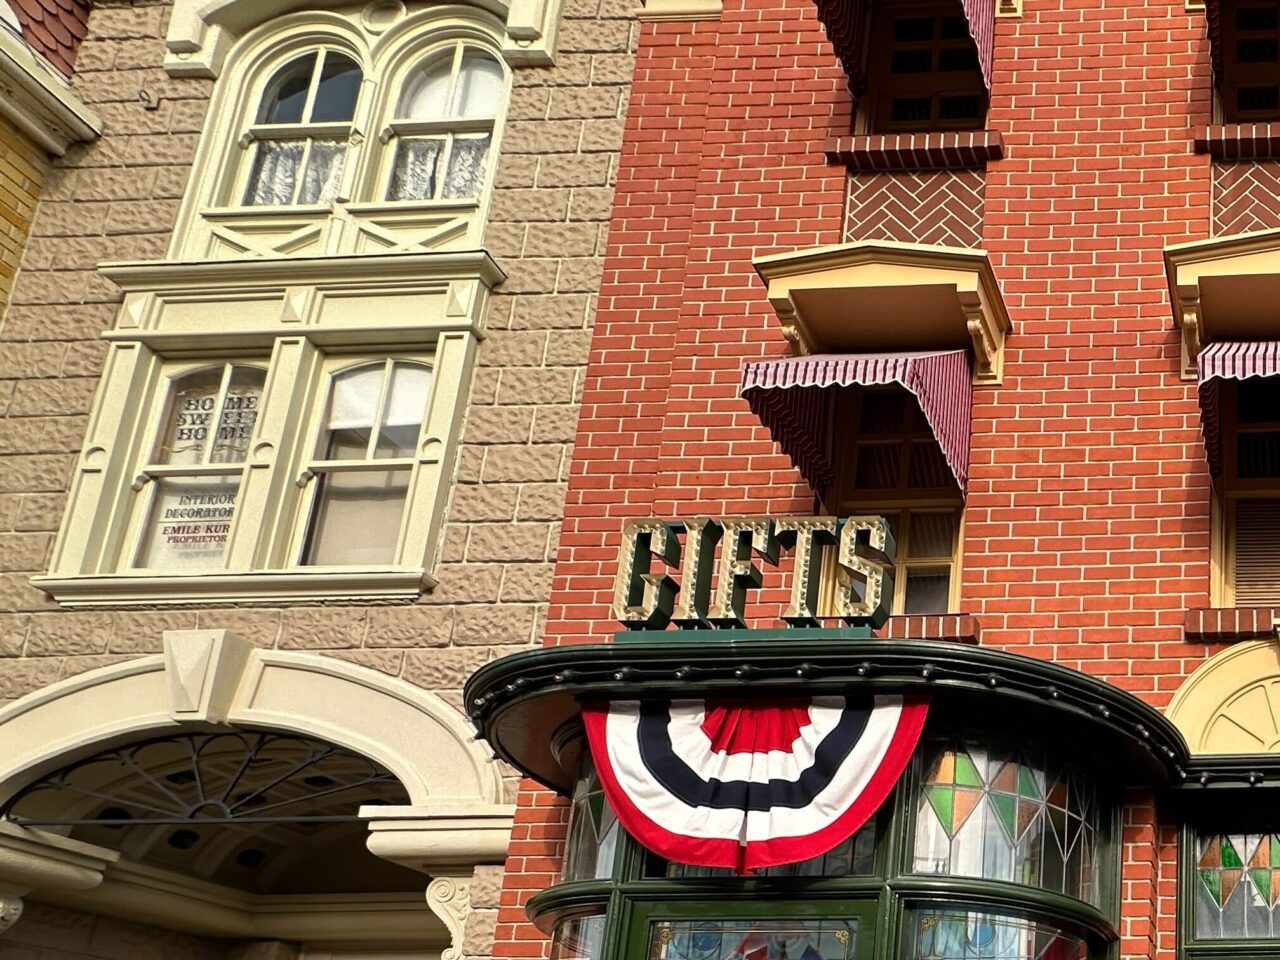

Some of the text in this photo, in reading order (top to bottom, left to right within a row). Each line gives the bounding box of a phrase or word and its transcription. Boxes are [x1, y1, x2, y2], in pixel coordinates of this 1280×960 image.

[184, 396, 258, 412] HOME
[176, 427, 251, 441] HOME
[179, 494, 236, 506] INTERIOR
[164, 506, 235, 519] DECORATOR
[162, 525, 201, 535] EMILE
[167, 534, 227, 544] PROPRIETOR
[613, 515, 895, 628] GIFTS
